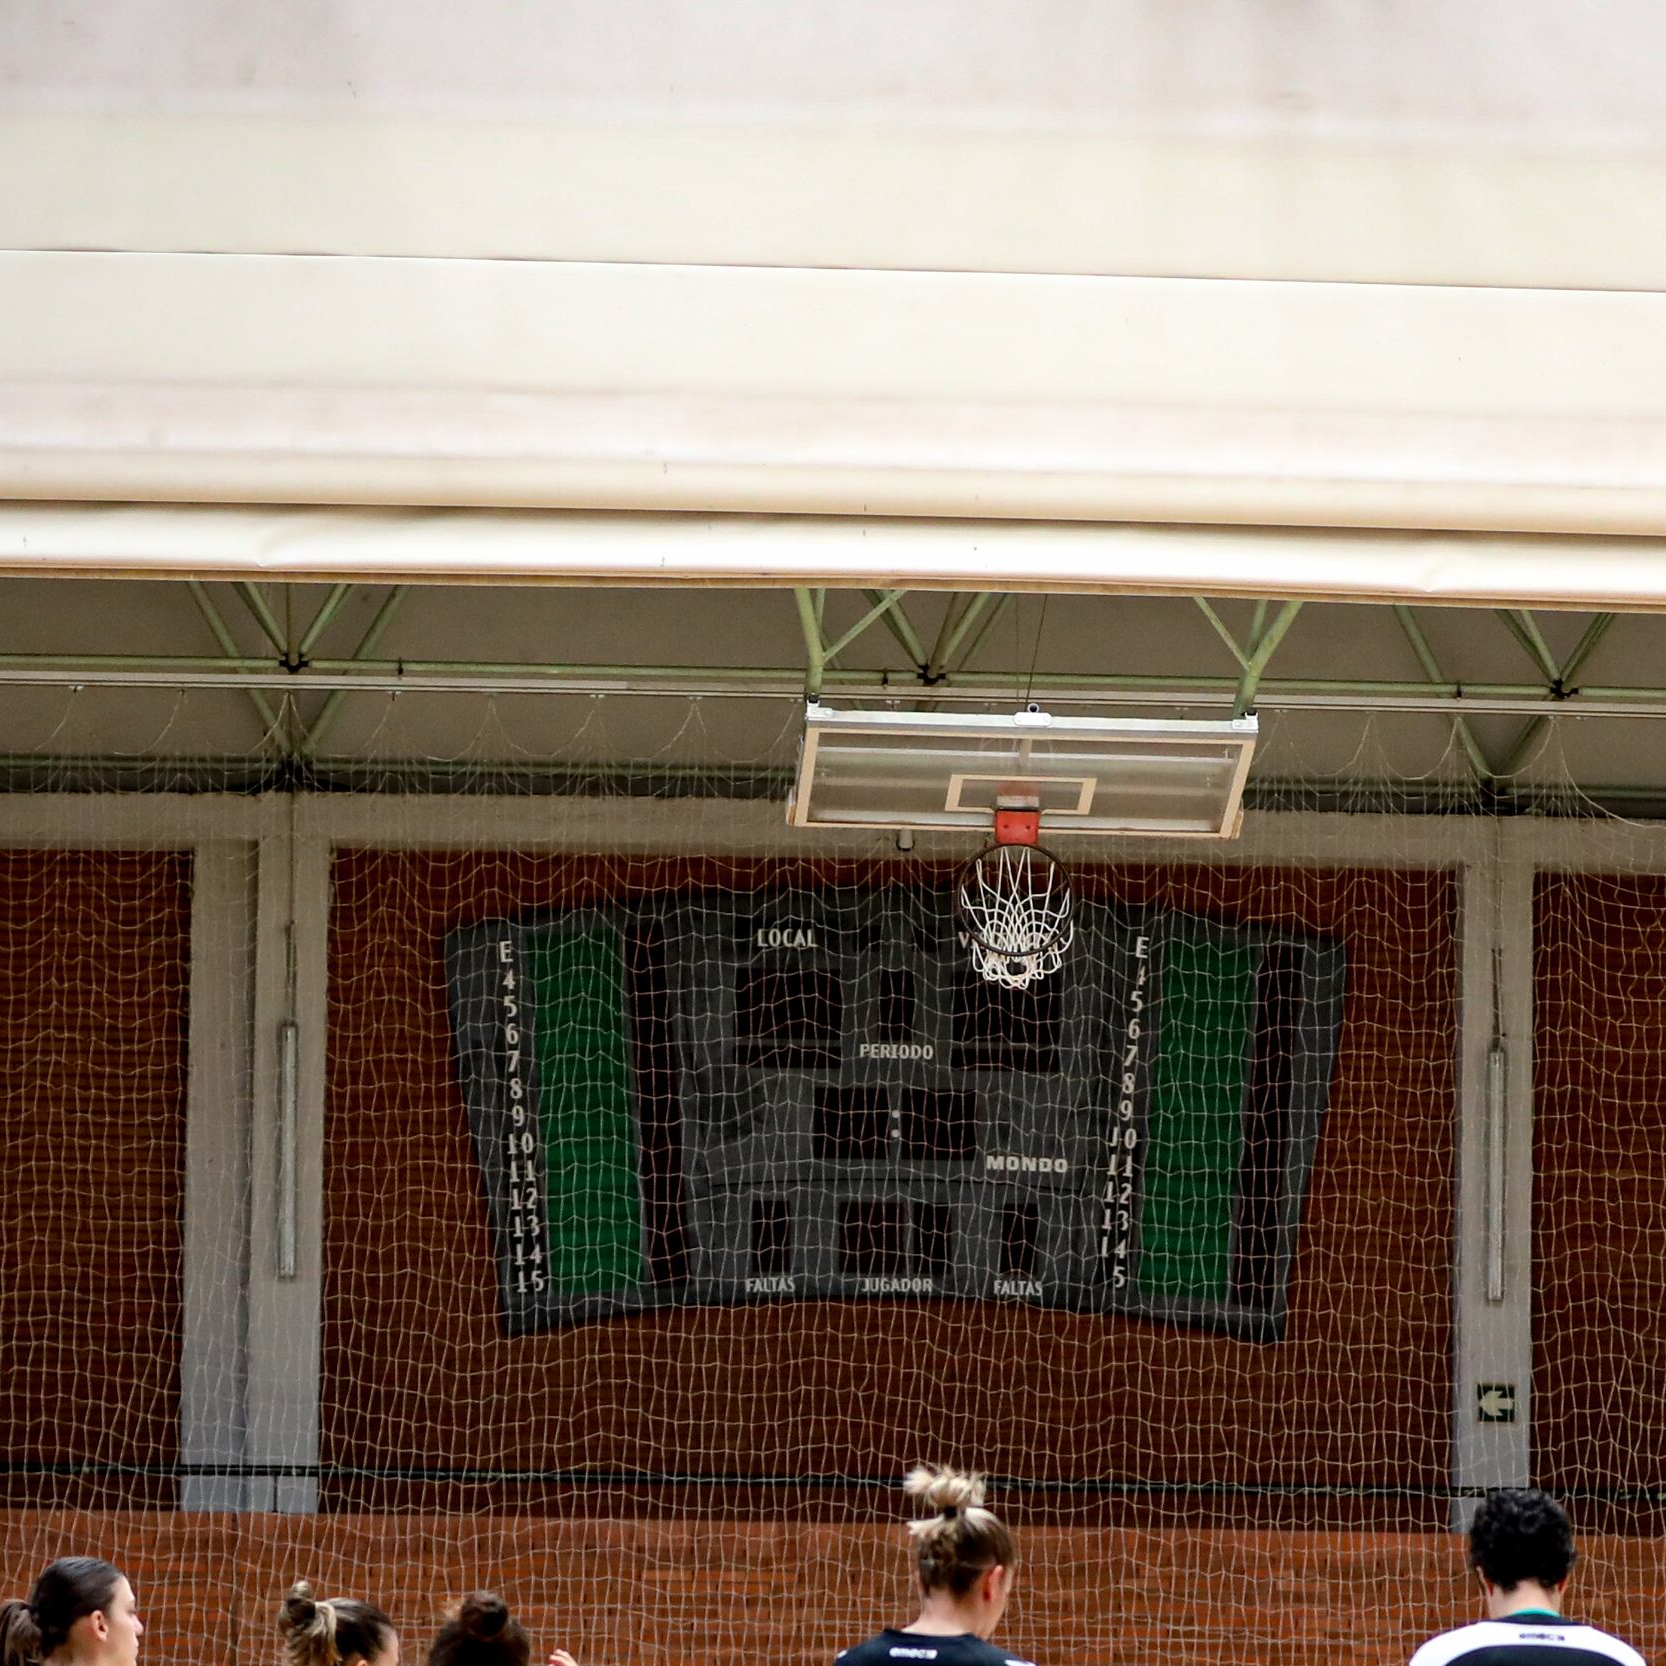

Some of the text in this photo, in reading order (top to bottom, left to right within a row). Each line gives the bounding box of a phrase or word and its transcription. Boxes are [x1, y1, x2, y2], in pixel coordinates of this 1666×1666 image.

[757, 928, 819, 948] LOCAL
[1135, 936, 1150, 959] E
[499, 940, 514, 963] E
[502, 968, 516, 990] 4
[503, 995, 518, 1018] 5
[1130, 990, 1143, 1013] 5
[505, 1023, 519, 1045] 6
[1128, 1018, 1141, 1040] 6
[507, 1050, 520, 1073] 7
[859, 1043, 933, 1059] PERIODO
[1124, 1045, 1138, 1067] 7
[509, 1077, 523, 1099] 8
[1122, 1072, 1135, 1094] 8
[511, 1105, 525, 1127] 9
[1120, 1099, 1133, 1121] 9
[507, 1132, 534, 1154] 10
[1109, 1126, 1137, 1149] 10
[509, 1160, 536, 1182] 11
[986, 1154, 1069, 1174] MONDO
[1106, 1154, 1133, 1177] 11
[511, 1187, 538, 1210] 12
[1104, 1181, 1132, 1204] 12
[513, 1215, 541, 1237] 13
[1101, 1208, 1129, 1231] 13
[515, 1243, 542, 1265] 14
[1101, 1236, 1127, 1259] 14
[517, 1270, 545, 1293] 15
[745, 1278, 795, 1293] FALTAS
[861, 1278, 933, 1292] JUGADOR
[994, 1280, 1043, 1296] FALTAS
